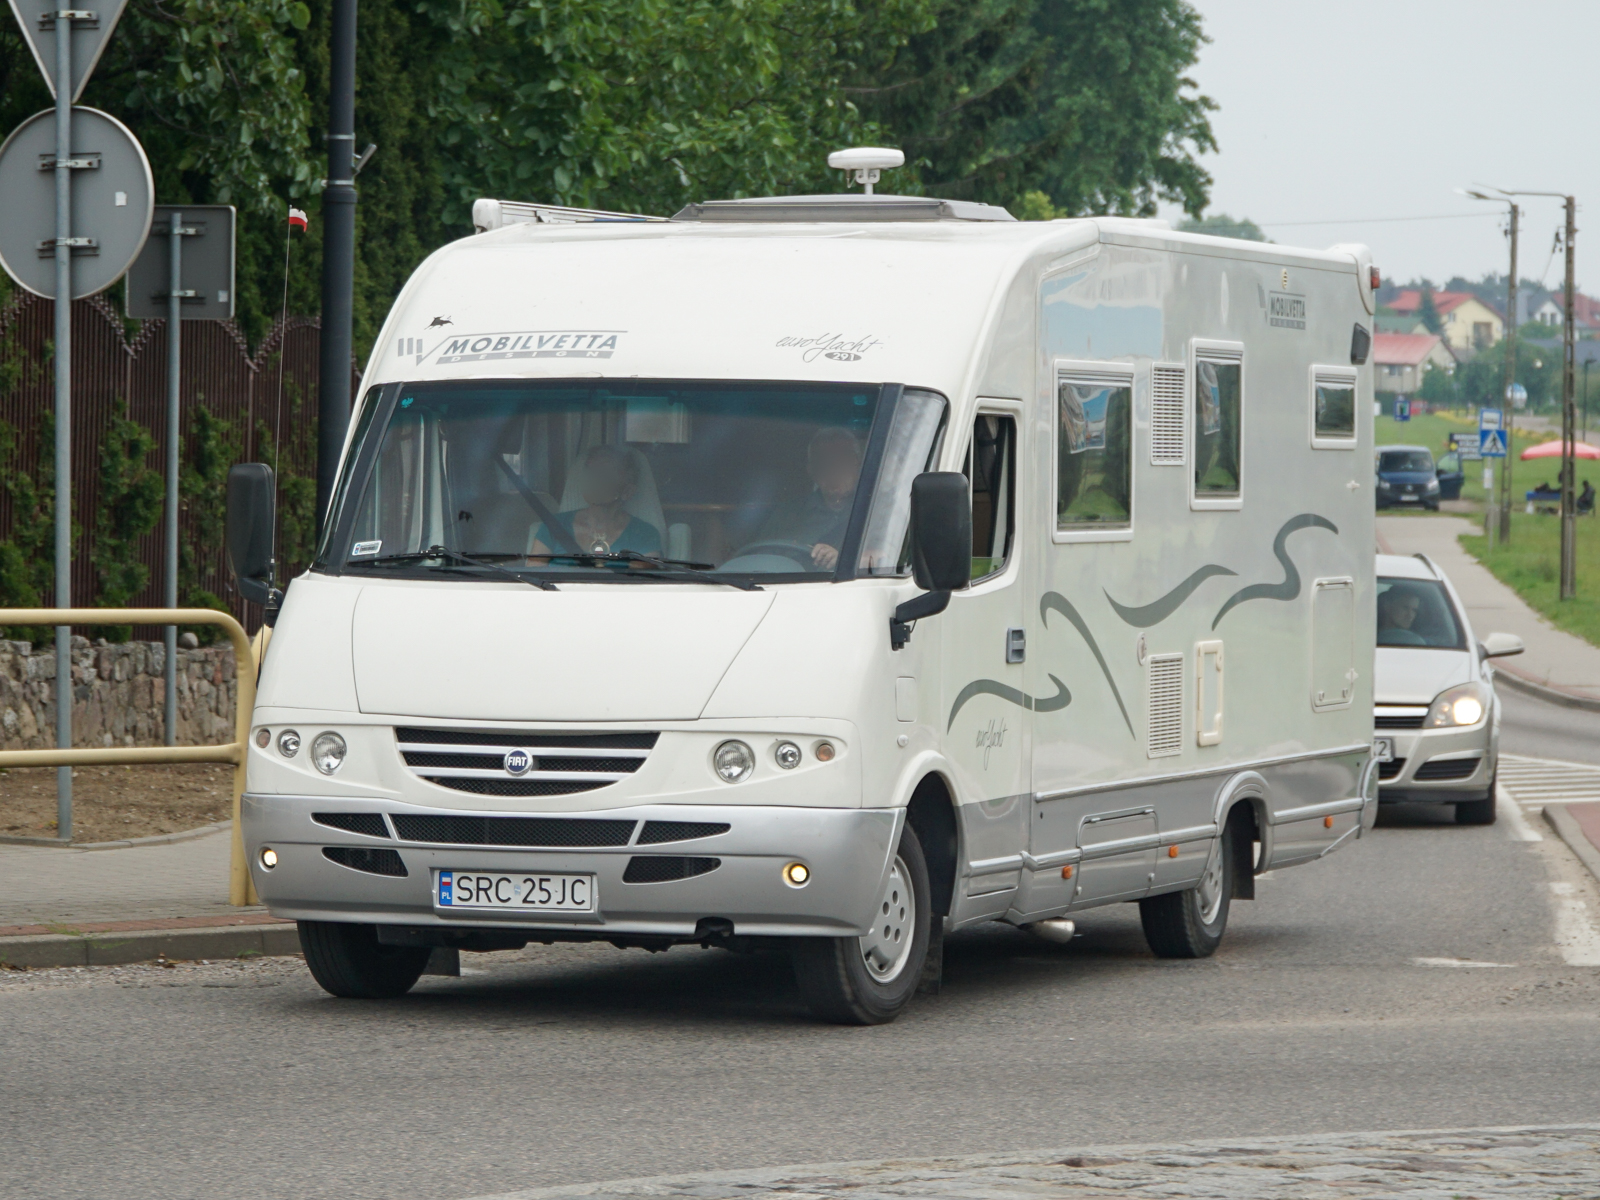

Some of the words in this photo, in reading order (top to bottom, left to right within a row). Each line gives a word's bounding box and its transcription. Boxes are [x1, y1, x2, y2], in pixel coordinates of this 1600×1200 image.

[443, 335, 618, 355] MOBILVETTA
[450, 350, 600, 363] DESIGN
[832, 352, 855, 361] 291
[507, 756, 528, 767] FIAT
[441, 892, 451, 900] PL
[457, 876, 512, 902] SRC
[522, 878, 586, 905] 25JC
